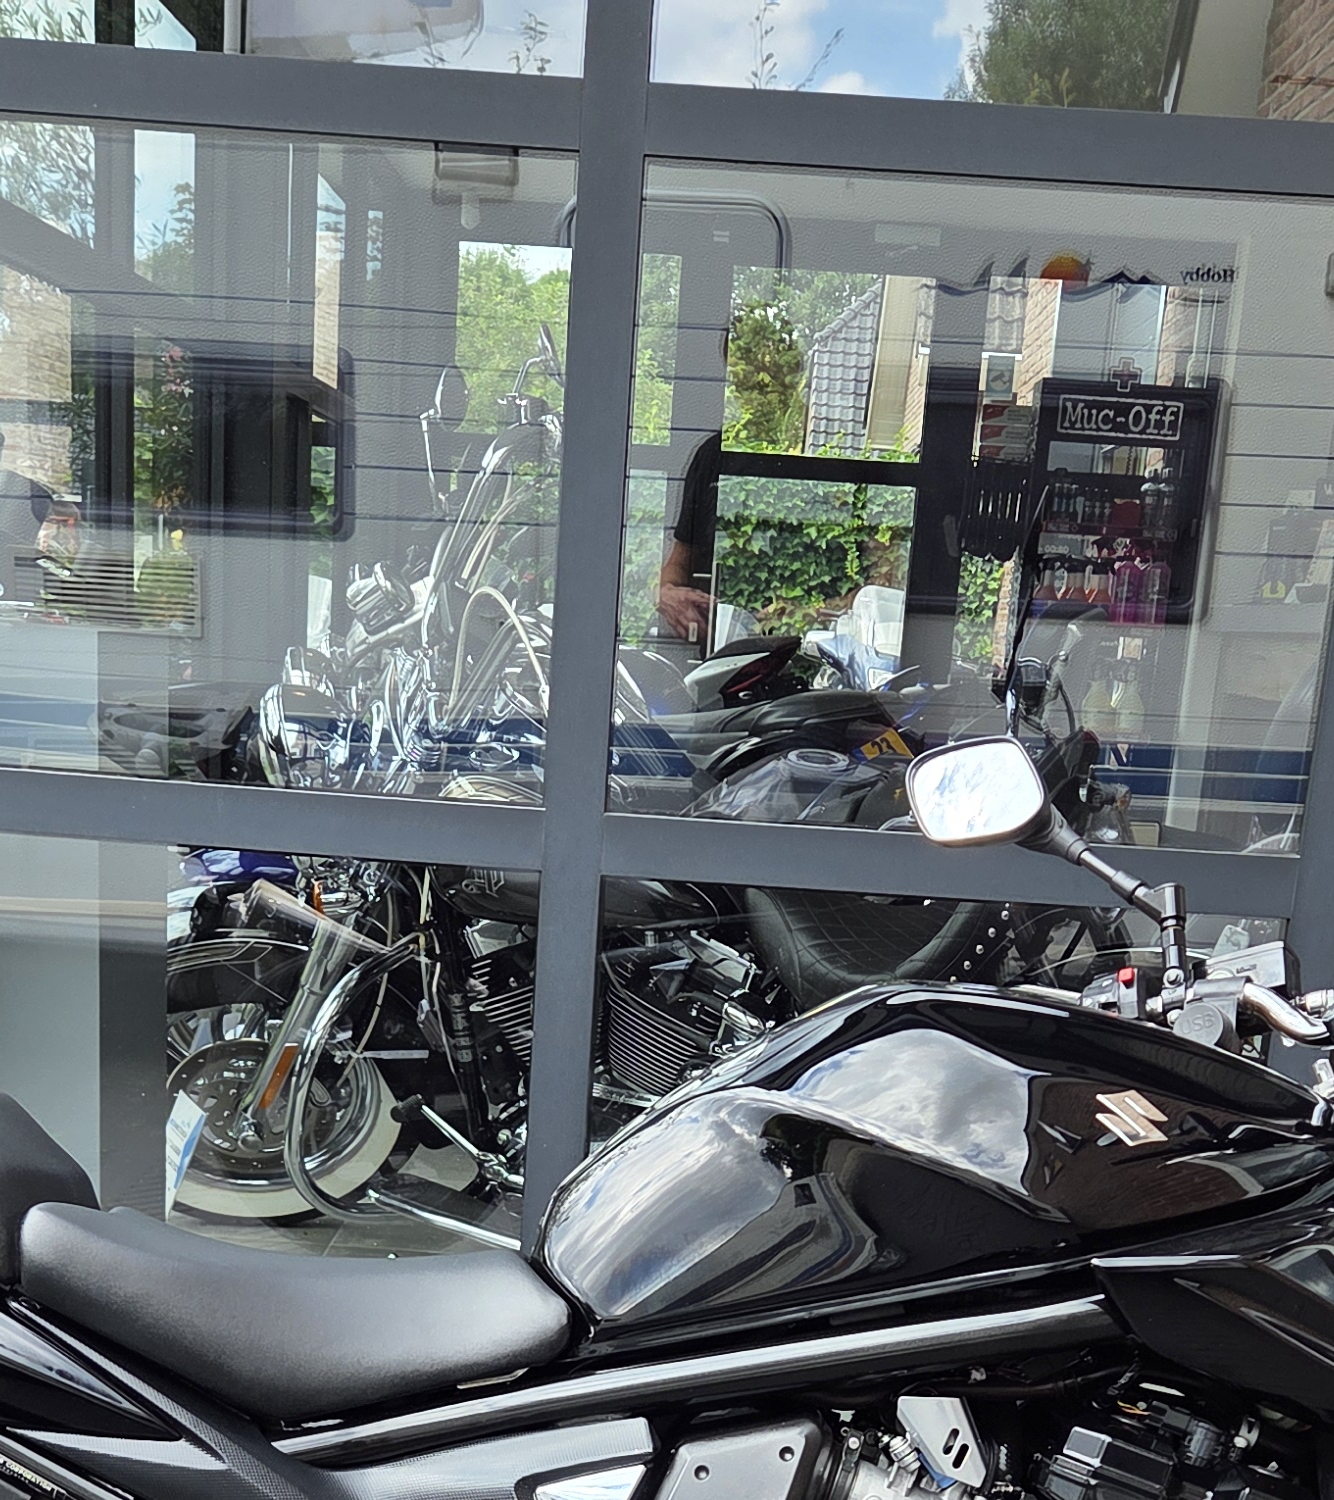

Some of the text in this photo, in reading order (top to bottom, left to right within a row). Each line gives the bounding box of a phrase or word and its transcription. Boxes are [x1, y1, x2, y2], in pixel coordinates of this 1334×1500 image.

[1062, 401, 1178, 435] Muc-Off
[1179, 1011, 1215, 1035] USB
[5, 1457, 53, 1493] CORPORATION
